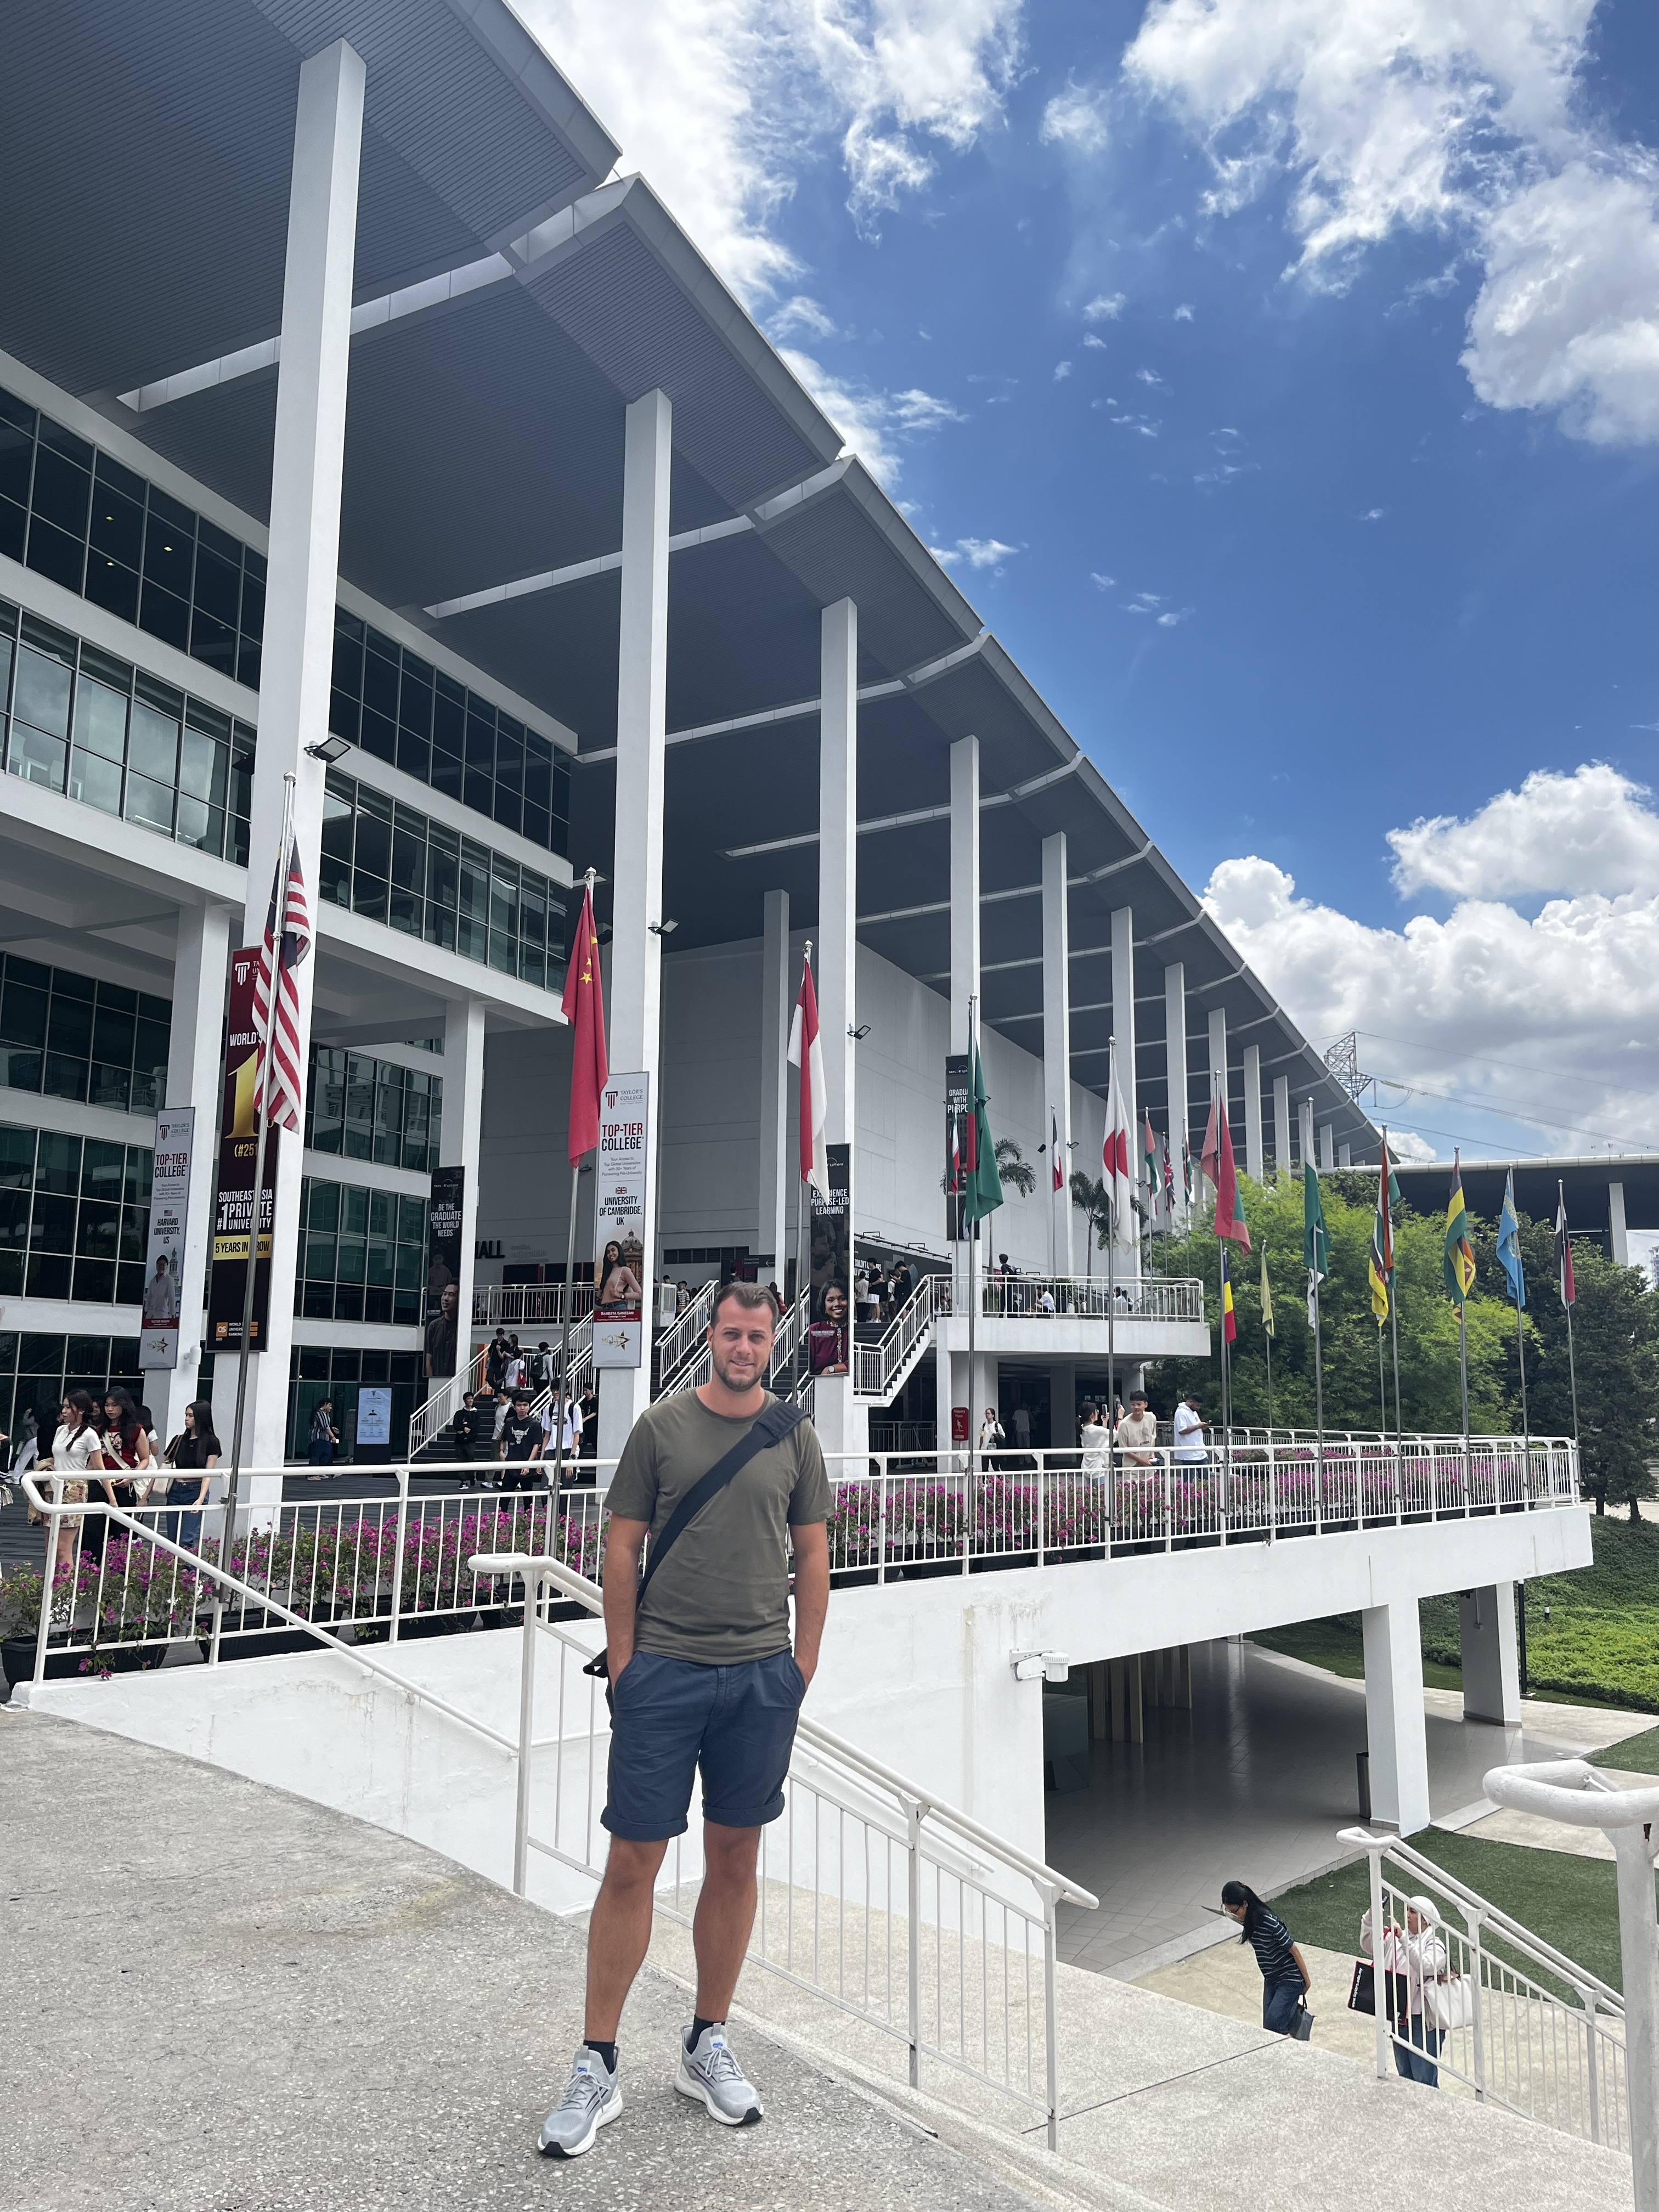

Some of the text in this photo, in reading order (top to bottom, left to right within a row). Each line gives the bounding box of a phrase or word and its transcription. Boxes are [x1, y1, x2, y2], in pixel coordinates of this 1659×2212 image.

[949, 1088, 968, 1097] GRADU
[602, 1122, 643, 1138] TOP-TIER
[155, 1153, 188, 1166] TOP-TIER
[261, 1189, 273, 1200] SIA
[605, 1195, 638, 1206] UNIVERSITY
[445, 1203, 455, 1211] THE
[599, 1206, 642, 1216] OF CAMBRIDGE,
[816, 1206, 844, 1215] LEARNING
[217, 1201, 273, 1231] #1 PRIVTE
[431, 1211, 462, 1221] GRADUATE
[157, 1217, 178, 1226] HARVARD
[228, 1217, 272, 1230] UNIVEITY
[432, 1221, 459, 1229] THE WORLD
[616, 1217, 624, 1226] UK
[154, 1227, 180, 1235] UNIVERSITY,
[437, 1229, 453, 1237] NEEDS
[163, 1236, 170, 1244] US
[215, 1243, 220, 1254] 5
[221, 1242, 241, 1253] YEARS
[241, 1241, 249, 1252] IN
